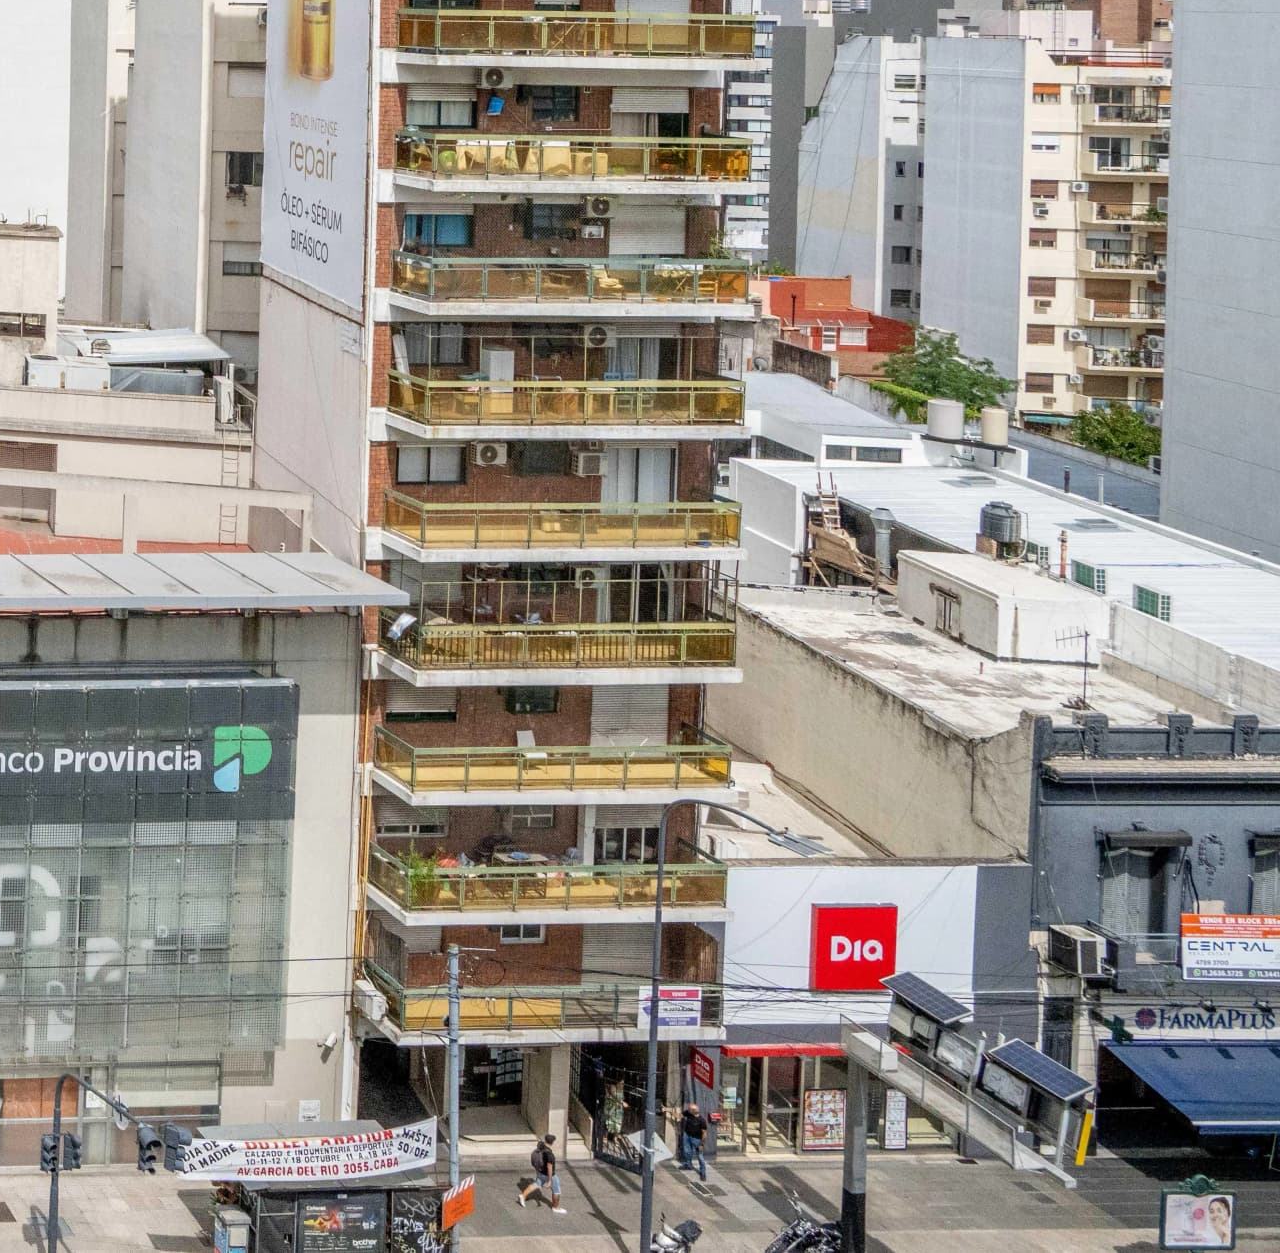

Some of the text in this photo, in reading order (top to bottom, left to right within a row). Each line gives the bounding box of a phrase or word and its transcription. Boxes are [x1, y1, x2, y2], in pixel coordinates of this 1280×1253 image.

[311, 117, 338, 137] INTENSE
[289, 139, 337, 182] repair
[281, 188, 304, 219] ÓLEO
[311, 199, 343, 234] SÉRUM
[290, 229, 329, 264] BIFÁSICO
[53, 745, 202, 773] Provincia
[1188, 940, 1274, 952] CENTRAL
[198, 1143, 238, 1169] MADRE
[203, 1140, 220, 1152] DE
[245, 1149, 283, 1158] CALZADO
[295, 1146, 351, 1157] INDUMENTARIA
[353, 1140, 394, 1152] DEPORTIVA
[304, 1155, 341, 1164] OCTUBRE
[297, 1166, 316, 1176] DEL
[320, 1165, 339, 1176] RIO
